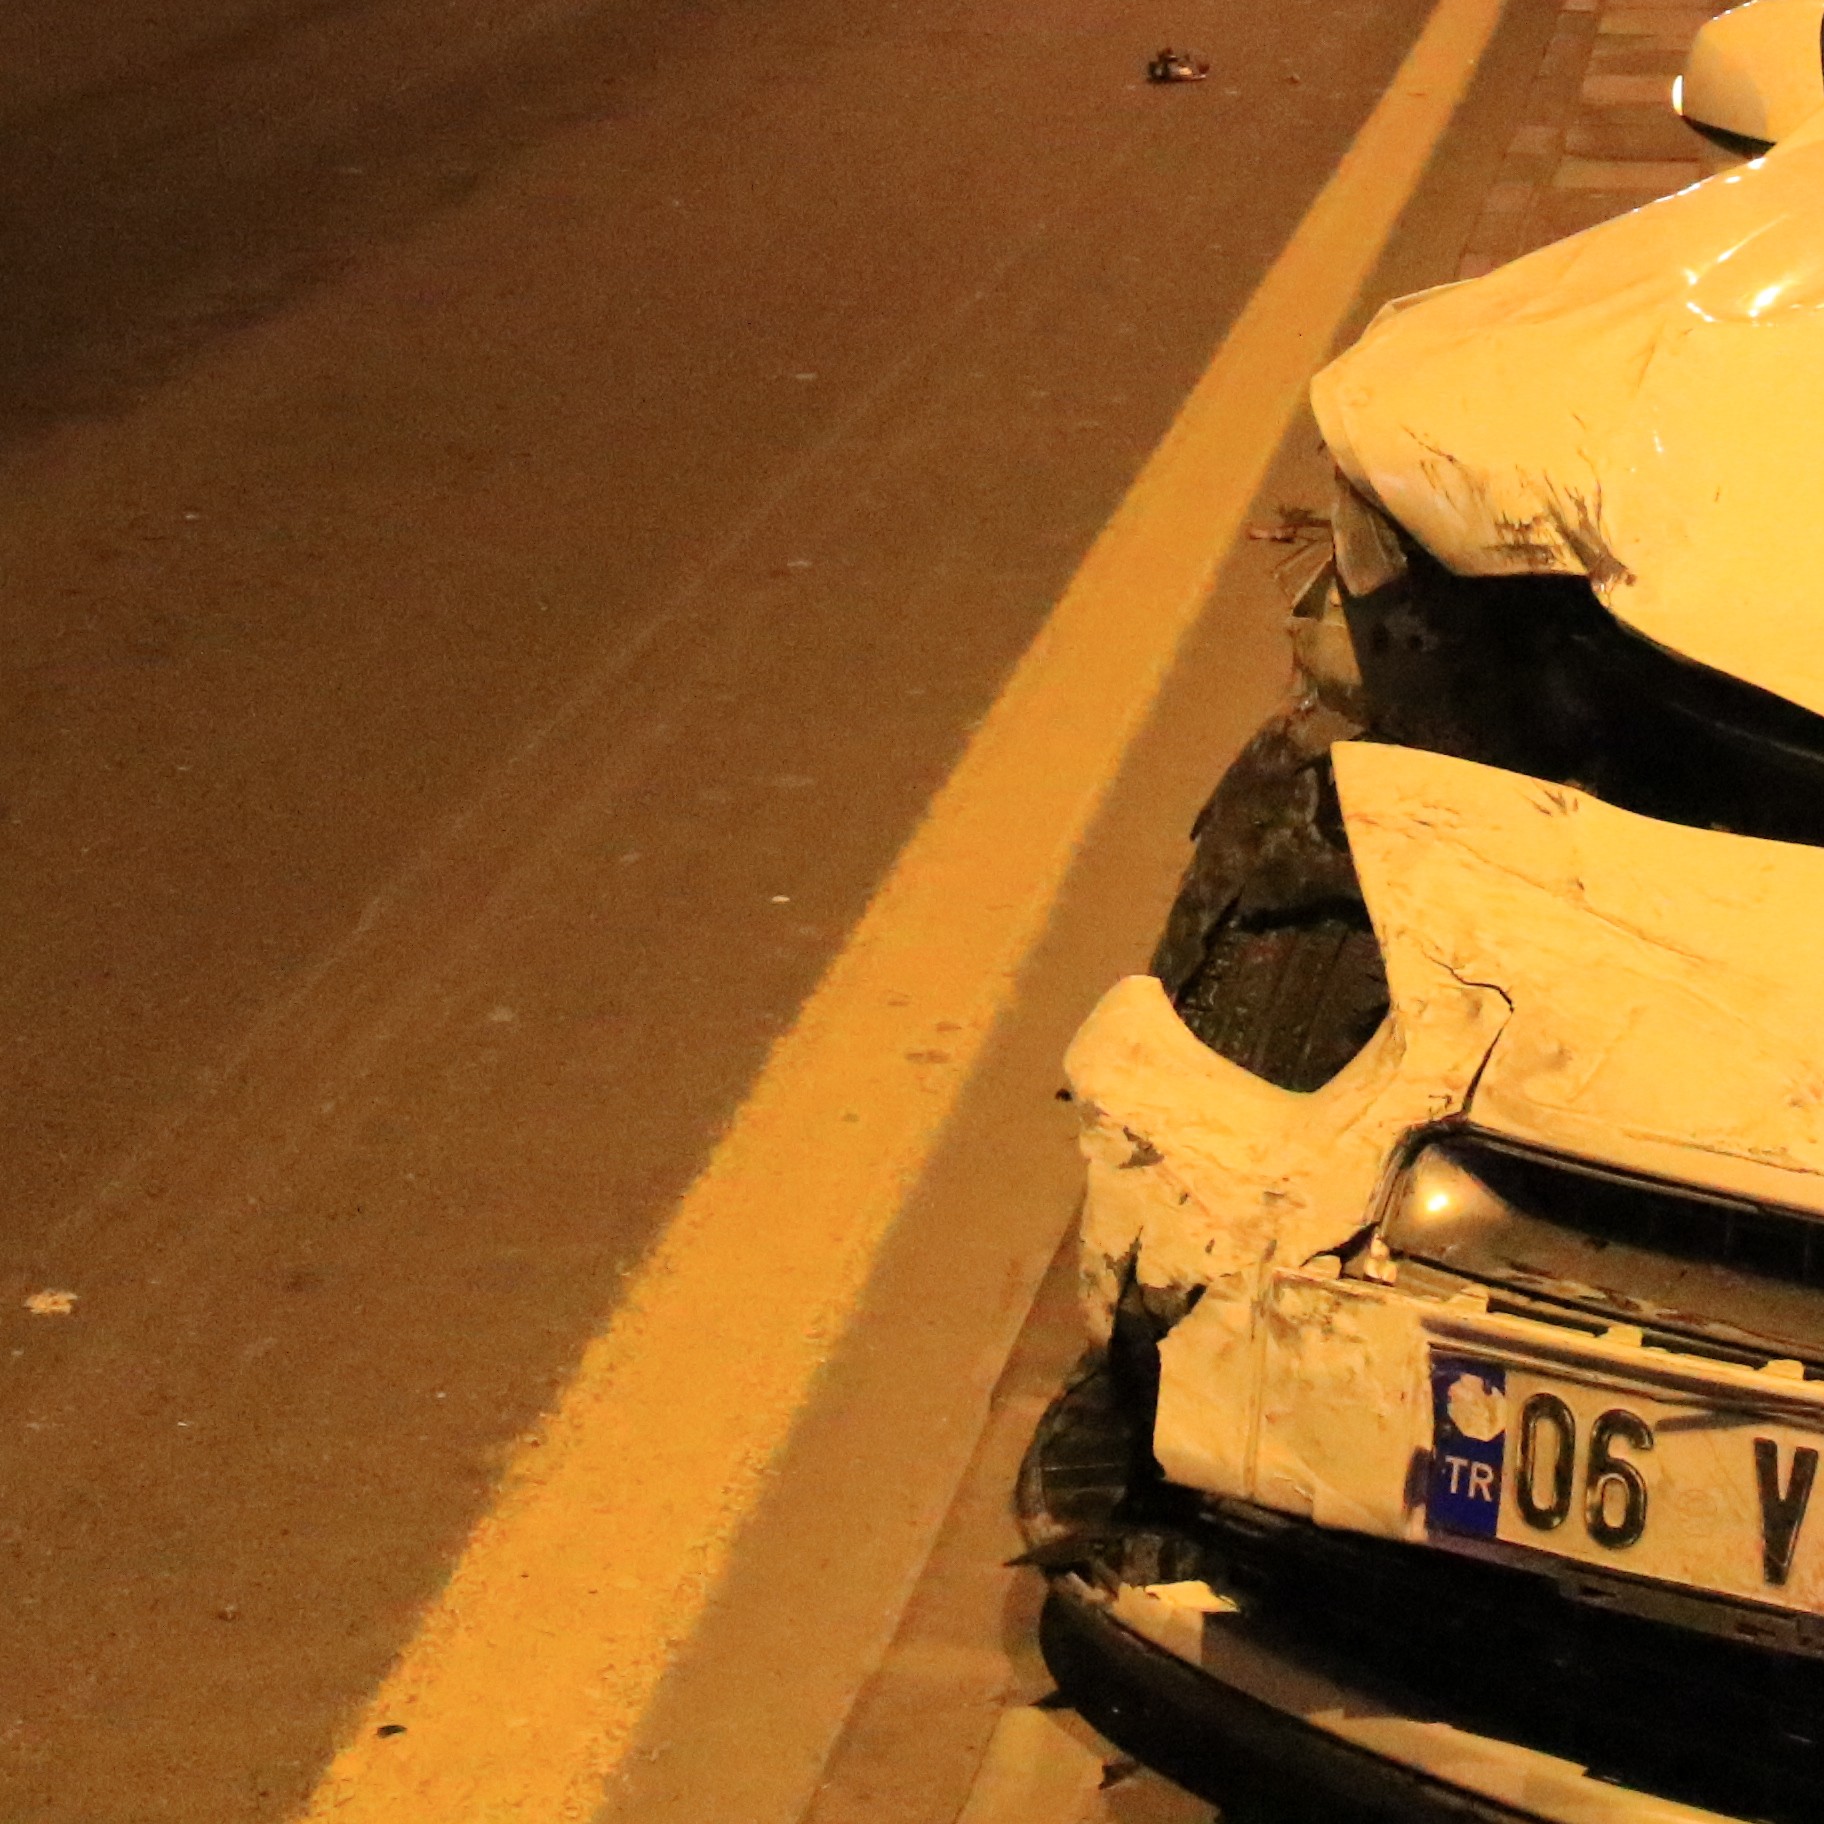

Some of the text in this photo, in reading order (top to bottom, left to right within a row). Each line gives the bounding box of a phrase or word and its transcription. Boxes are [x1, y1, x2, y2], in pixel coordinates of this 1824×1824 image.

[1444, 1454, 1494, 1502] TR
[1516, 1391, 1654, 1549] 06
[1753, 1436, 1819, 1586] V
